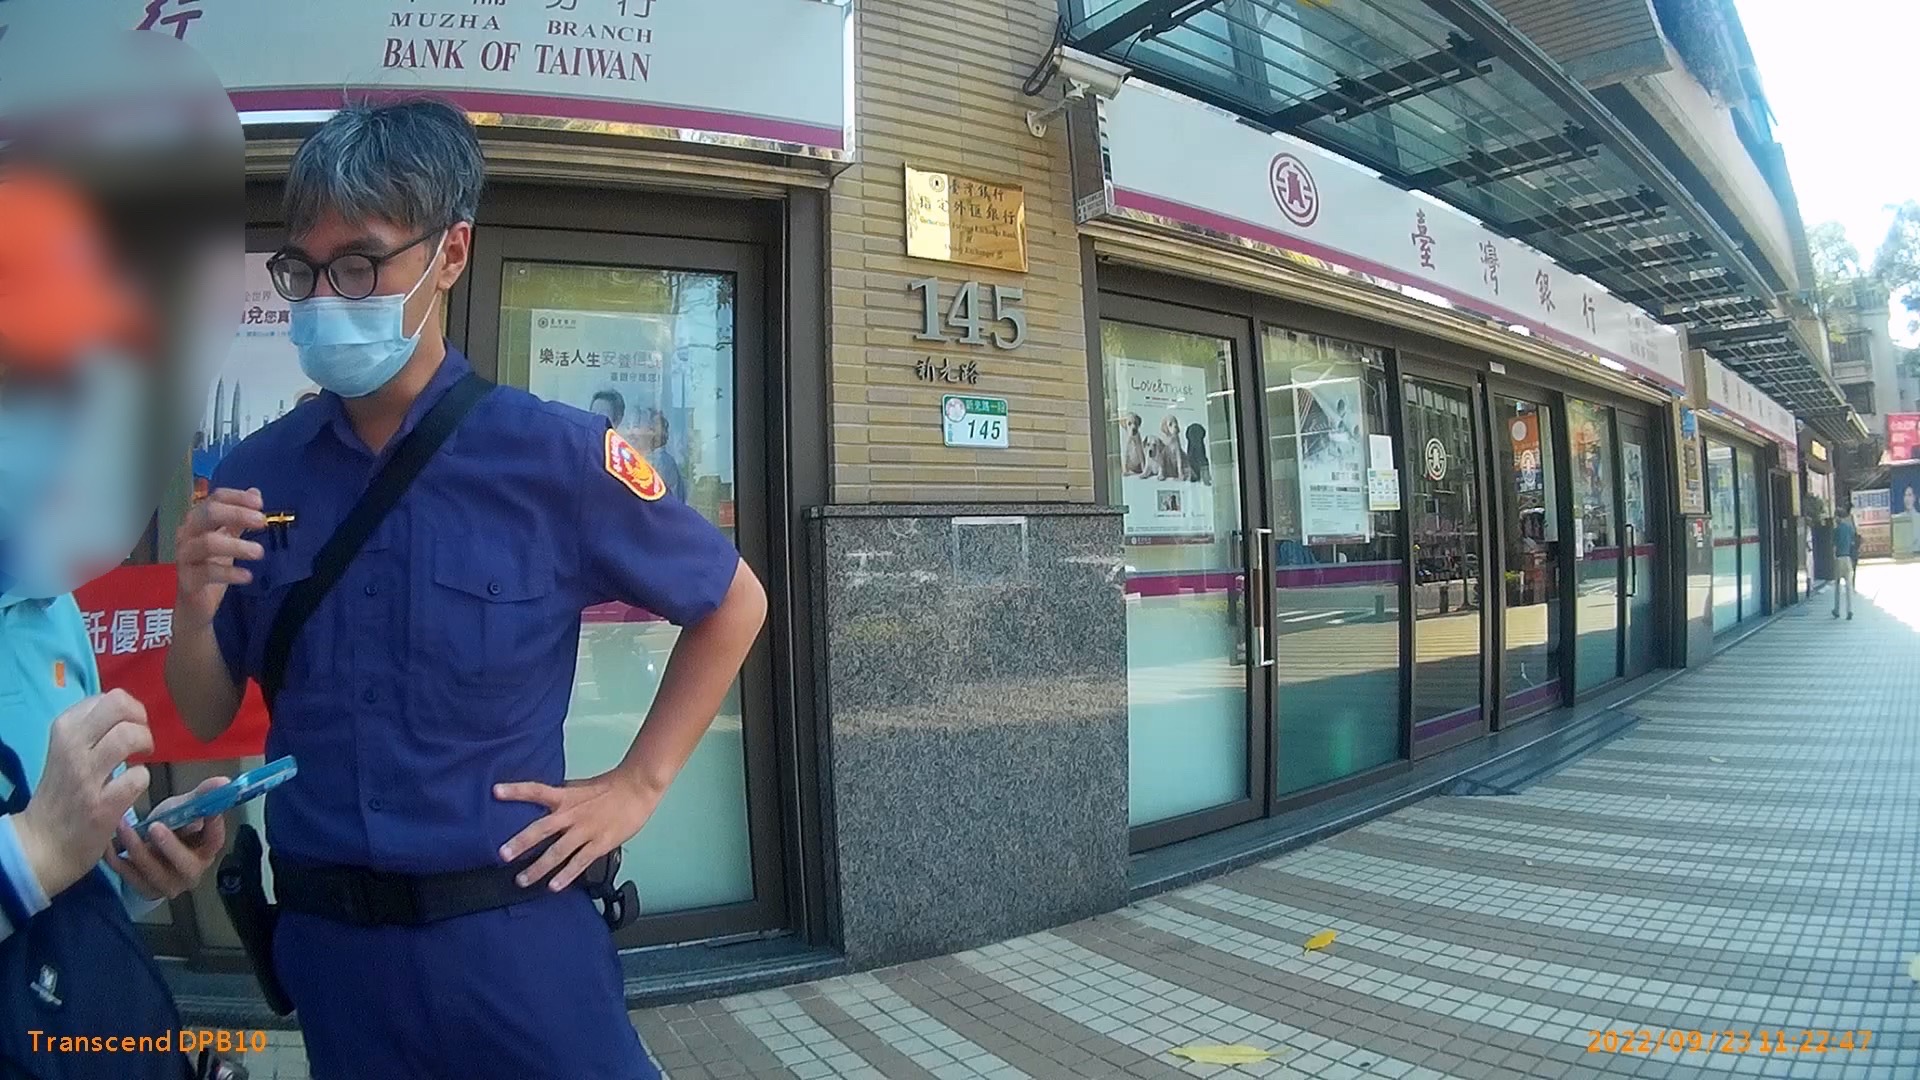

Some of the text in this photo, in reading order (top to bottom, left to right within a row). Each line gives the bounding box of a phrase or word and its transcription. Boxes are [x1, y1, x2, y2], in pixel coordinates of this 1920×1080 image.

[390, 12, 653, 43] MUZHA BRANCH
[382, 38, 652, 83] BANK OF TAIWAN
[1411, 208, 1598, 336] 臺灣銀行
[907, 277, 1028, 351] 145
[916, 356, 980, 385] 新光路
[968, 419, 1001, 440] 145
